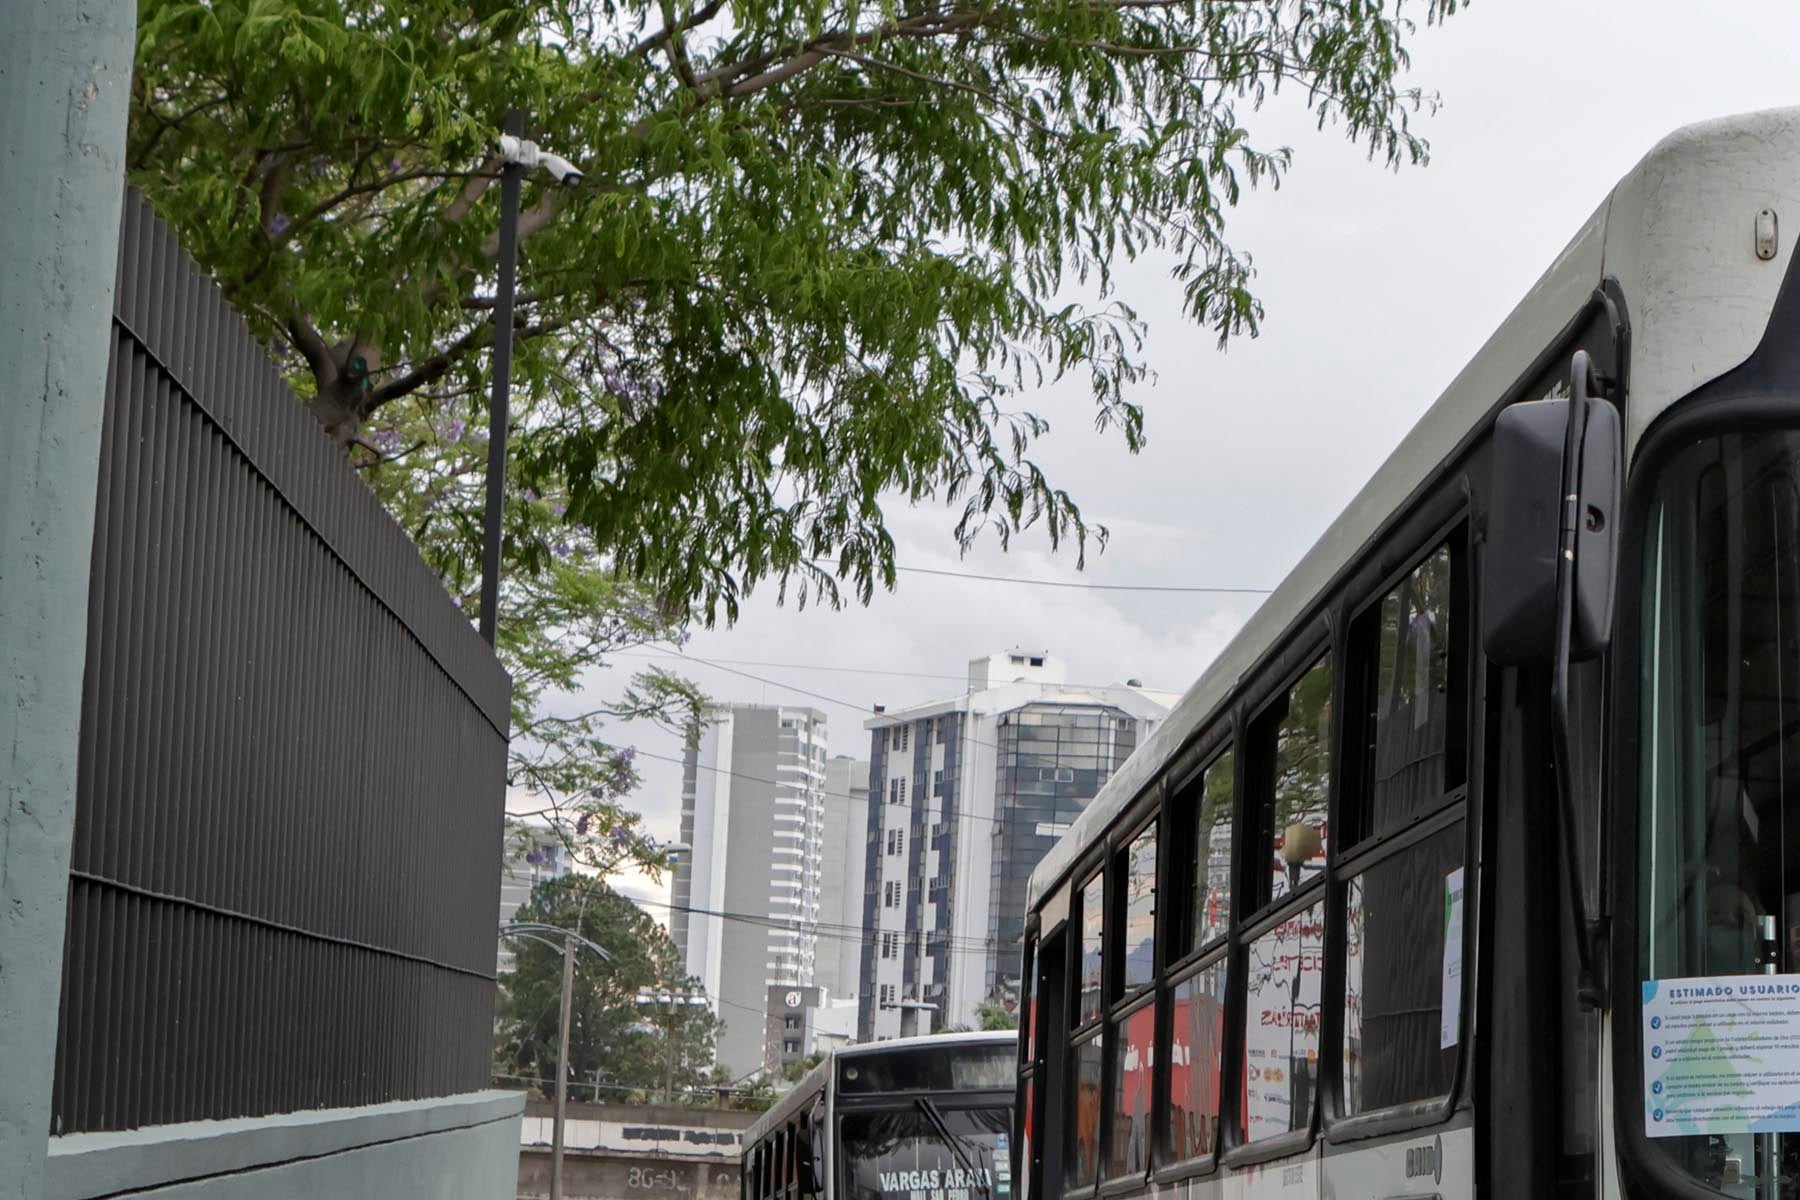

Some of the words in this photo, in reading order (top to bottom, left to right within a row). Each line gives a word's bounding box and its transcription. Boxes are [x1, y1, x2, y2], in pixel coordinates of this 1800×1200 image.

[1669, 987, 1733, 998] ESTIMADO
[1739, 984, 1800, 996] USUARIO
[880, 1170, 939, 1192] VARGAS
